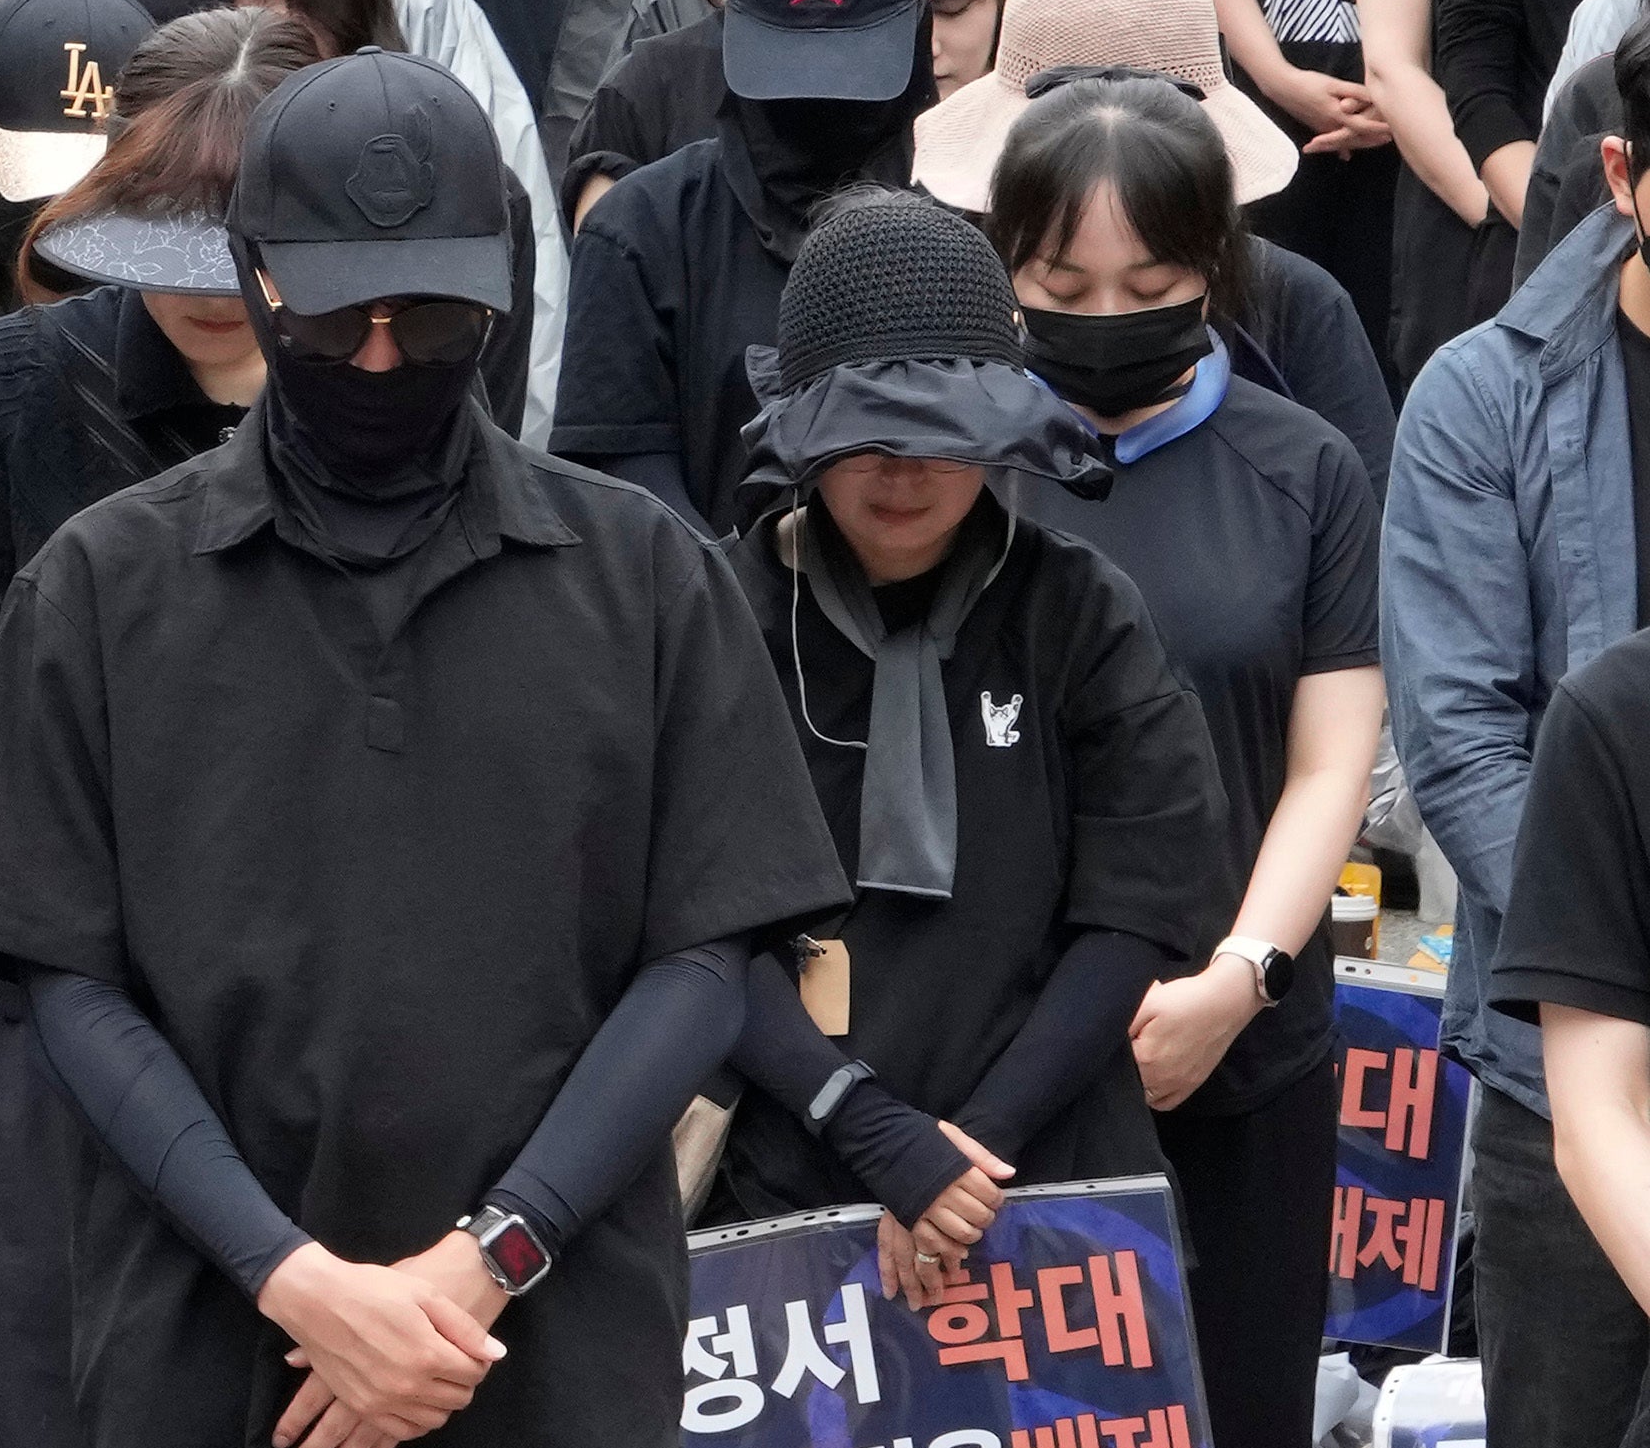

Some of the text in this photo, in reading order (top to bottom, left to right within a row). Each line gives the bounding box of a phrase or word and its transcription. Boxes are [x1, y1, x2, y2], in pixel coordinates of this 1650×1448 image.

[60, 43, 115, 118] LA
[1334, 1050, 1438, 1159] 대
[680, 1249, 1153, 1434] 정서 학대
